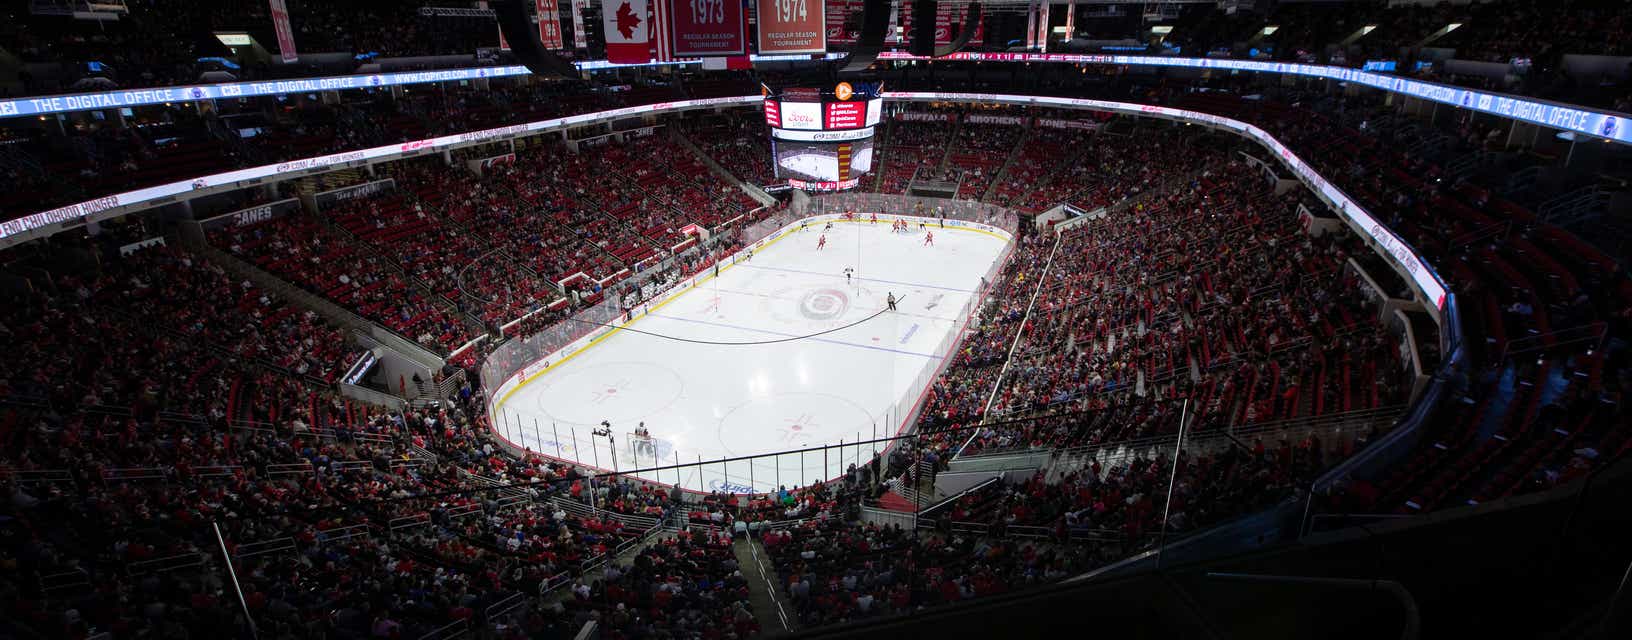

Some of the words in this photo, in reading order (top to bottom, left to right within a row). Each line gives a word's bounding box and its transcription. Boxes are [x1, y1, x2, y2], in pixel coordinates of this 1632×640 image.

[689, 0, 724, 24] 1973
[775, 0, 807, 23] 1974
[250, 82, 273, 94] THE
[277, 80, 316, 93] DIGITAL
[320, 77, 353, 91] OFFICE
[31, 98, 65, 113] THE
[65, 92, 122, 109] DIGITAL
[126, 89, 175, 104] OFFICE
[902, 113, 947, 121] BUFFALO
[969, 115, 1022, 125] BROTHERS
[1495, 97, 1514, 115] THE
[1512, 100, 1547, 124] DIGITAL
[1548, 106, 1590, 131] OFFICE
[3, 220, 24, 236] END
[23, 206, 81, 230] CHILDHOOD
[81, 196, 119, 216] HUNGER
[232, 206, 272, 227] CANES
